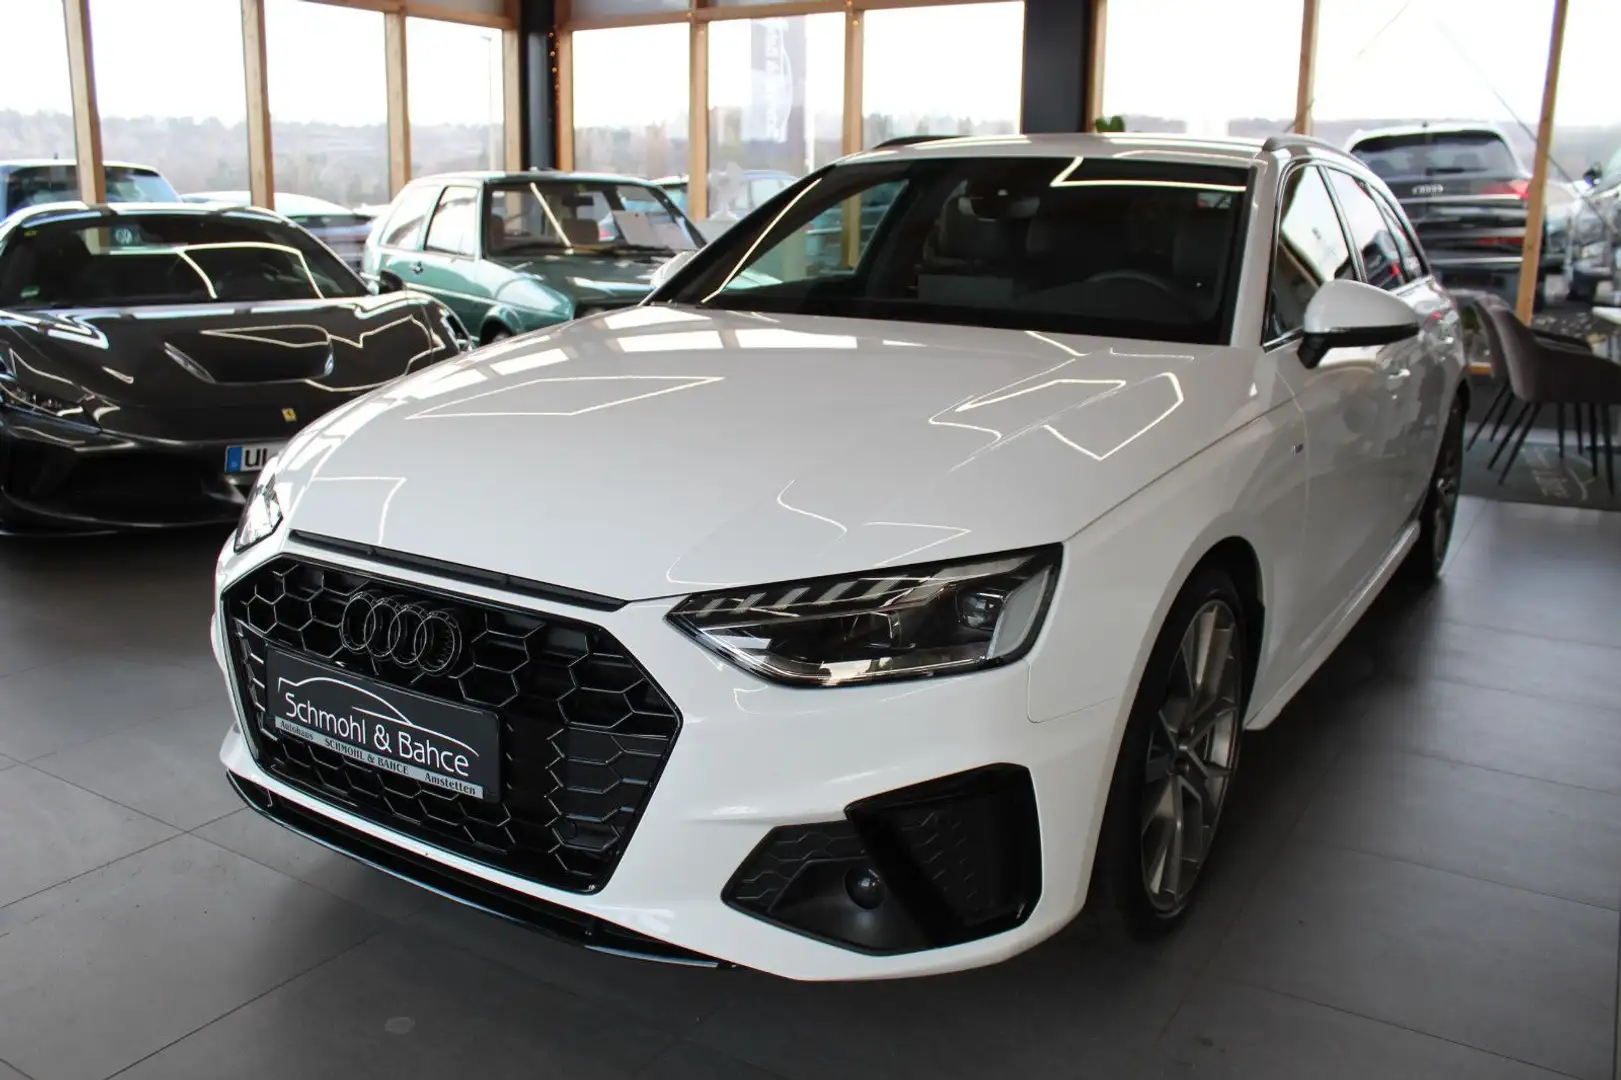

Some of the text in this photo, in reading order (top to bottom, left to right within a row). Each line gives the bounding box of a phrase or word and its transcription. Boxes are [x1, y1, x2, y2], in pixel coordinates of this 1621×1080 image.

[280, 720, 476, 796] Autohaus SCHMOHL & BAHCE Amstetten
[285, 692, 469, 777] Schmohl & Bahce
